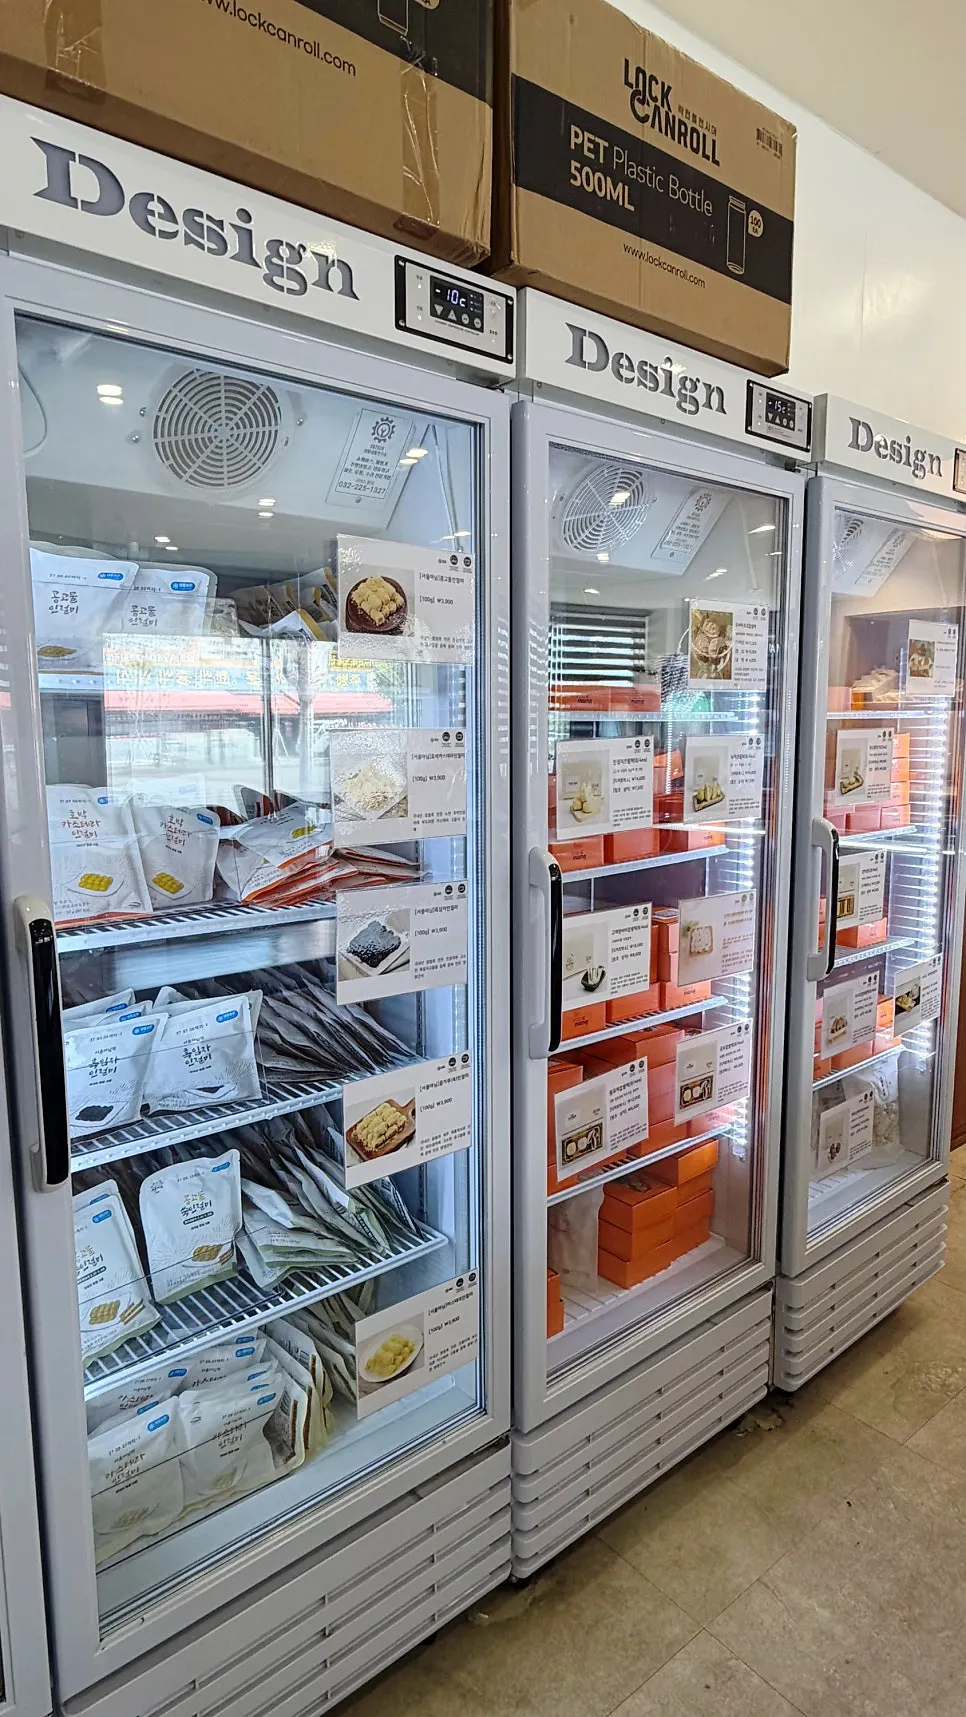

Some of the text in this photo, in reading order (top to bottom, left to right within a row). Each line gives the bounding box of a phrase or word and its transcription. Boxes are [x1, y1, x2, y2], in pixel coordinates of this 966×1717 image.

[624, 58, 672, 113] LOCK
[630, 88, 720, 167] CANROLL
[570, 124, 712, 217] PET Plastic Bottle
[570, 160, 635, 212] 500ML
[31, 136, 360, 301] Design
[750, 215, 762, 229] 100
[752, 225, 759, 235] EA
[623, 243, 706, 289] www.lockcanroll.com
[565, 322, 727, 415] Design
[848, 416, 943, 480] Design
[51, 591, 79, 604] 콩고물
[49, 604, 79, 615] 인절미
[129, 617, 158, 627] 인절미
[68, 810, 88, 820] 호박
[61, 820, 101, 828] 카스테라
[71, 830, 98, 839] 인절미
[182, 1044, 211, 1059] 흑임자
[89, 1056, 119, 1069] 흑임자
[185, 1053, 212, 1067] 인절미
[89, 1066, 118, 1079] 인절미
[180, 1199, 213, 1218] 쑥인절미
